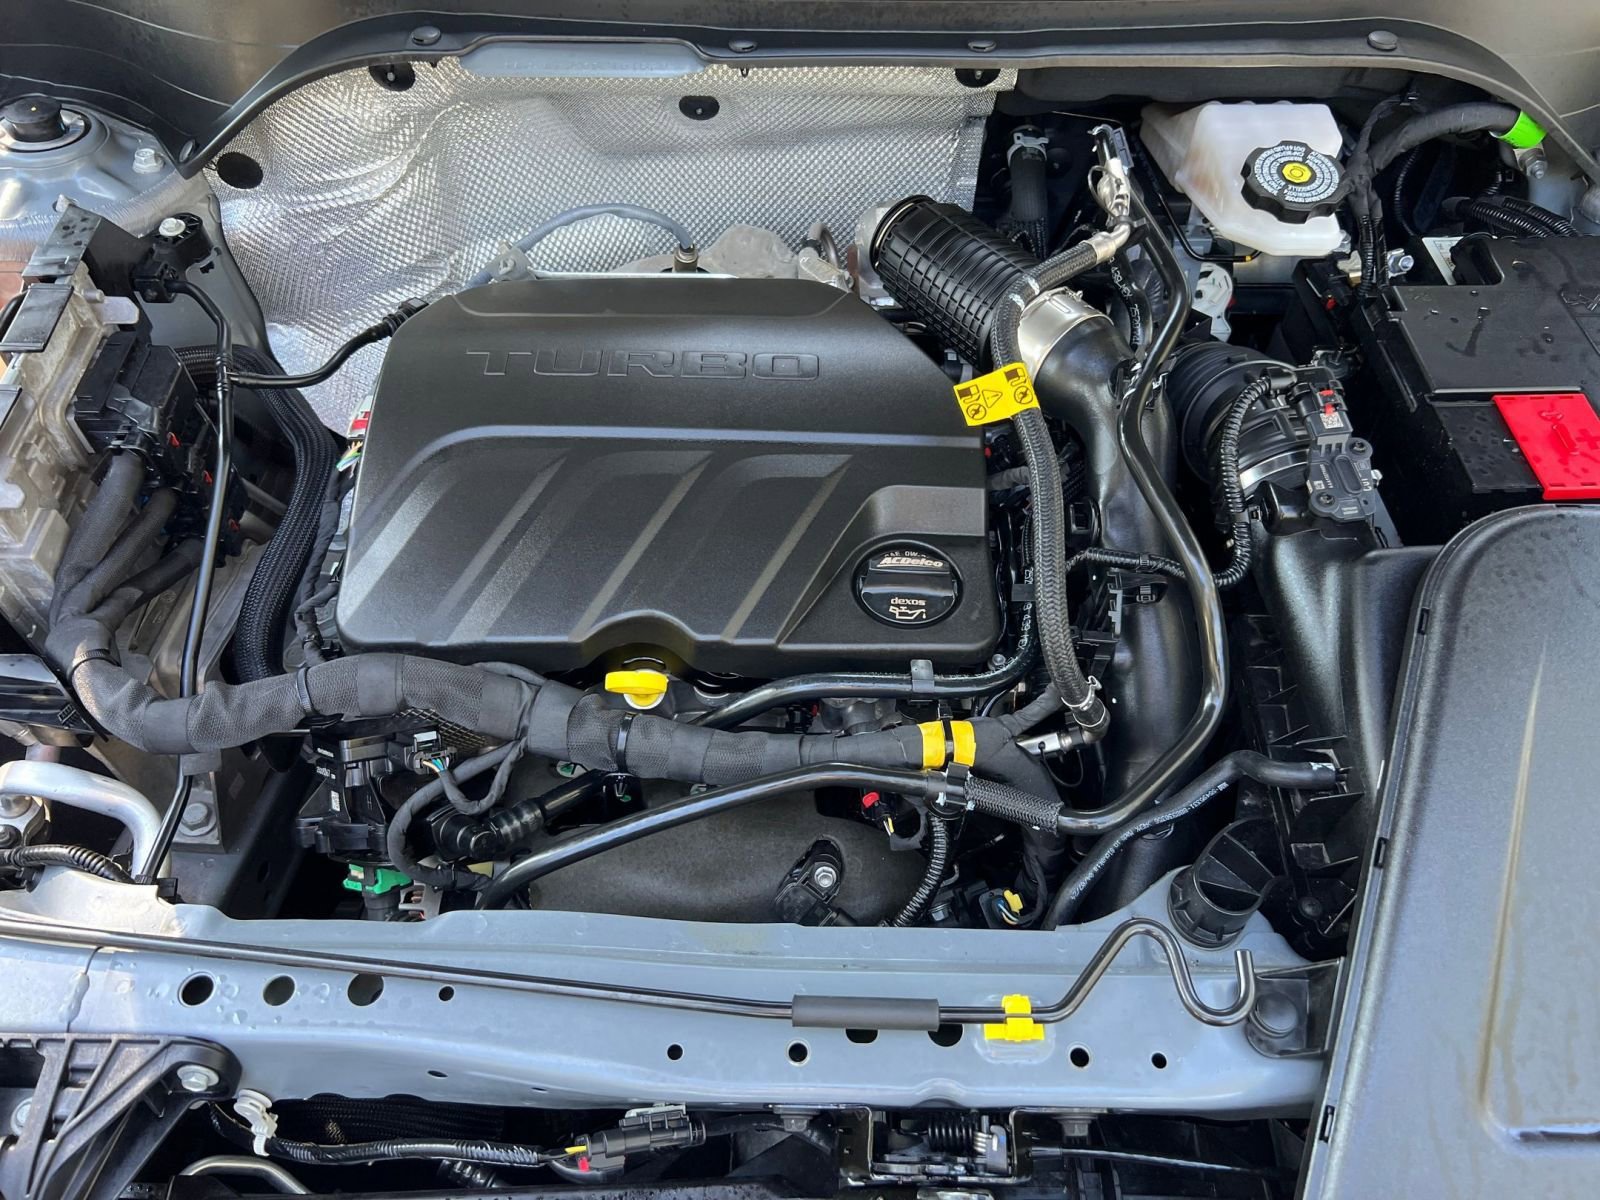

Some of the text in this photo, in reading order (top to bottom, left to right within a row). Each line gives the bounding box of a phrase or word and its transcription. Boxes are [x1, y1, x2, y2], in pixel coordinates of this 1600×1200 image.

[465, 350, 820, 380] TURBO
[877, 557, 943, 568] ACDelco
[890, 597, 927, 606] dexos
